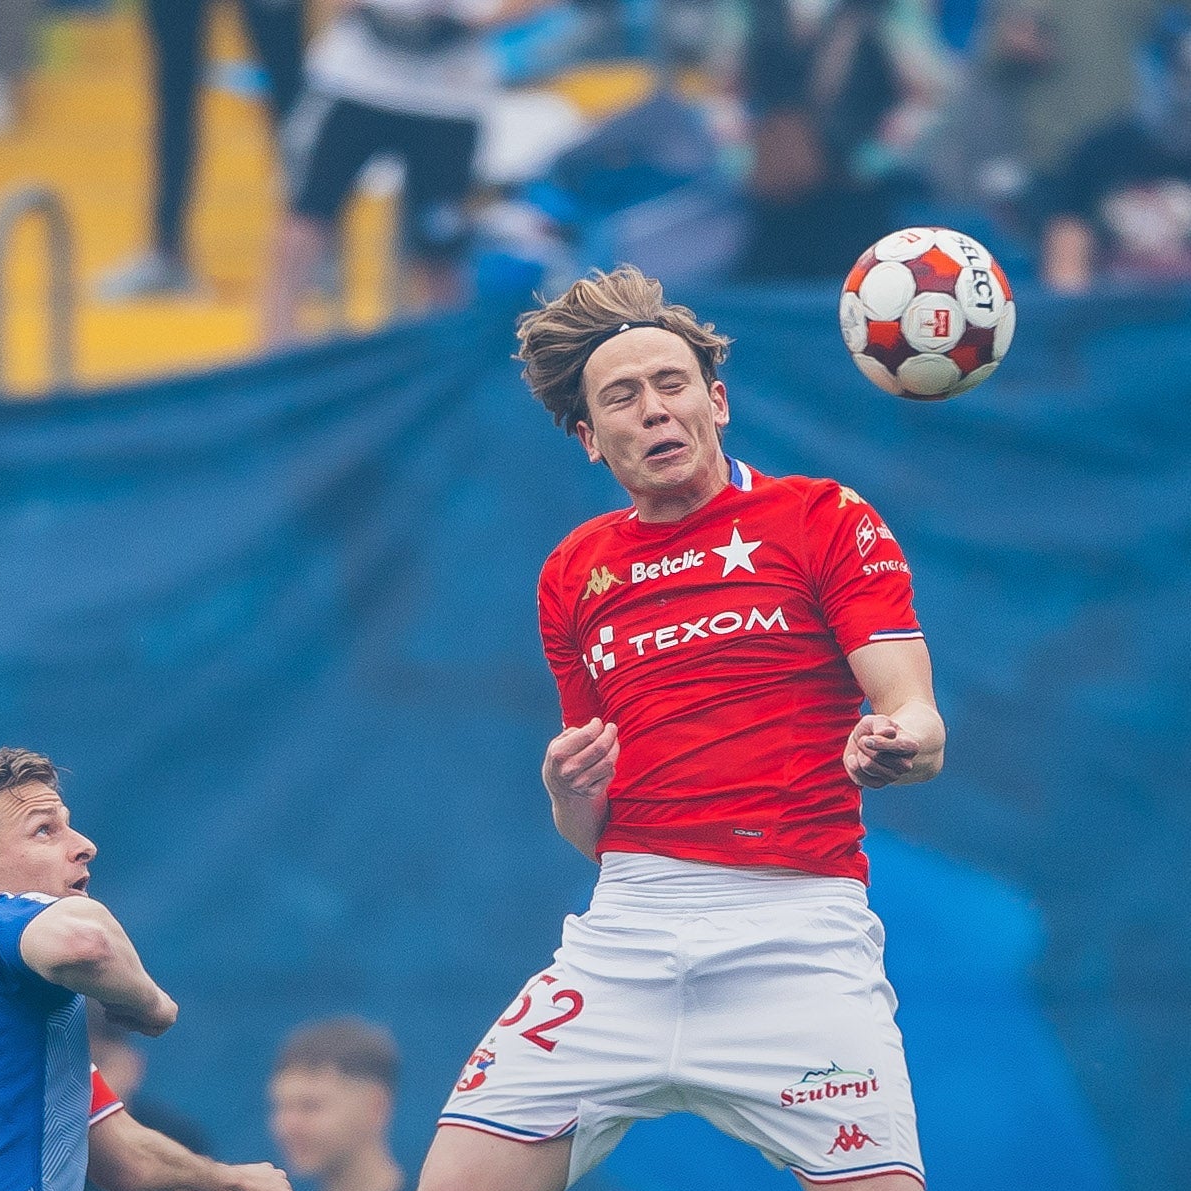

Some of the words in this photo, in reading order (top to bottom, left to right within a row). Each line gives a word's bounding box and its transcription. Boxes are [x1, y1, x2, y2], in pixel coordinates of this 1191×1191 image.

[952, 235, 994, 312] SELECT
[631, 549, 706, 583] Betclic
[628, 607, 790, 656] TEXOM
